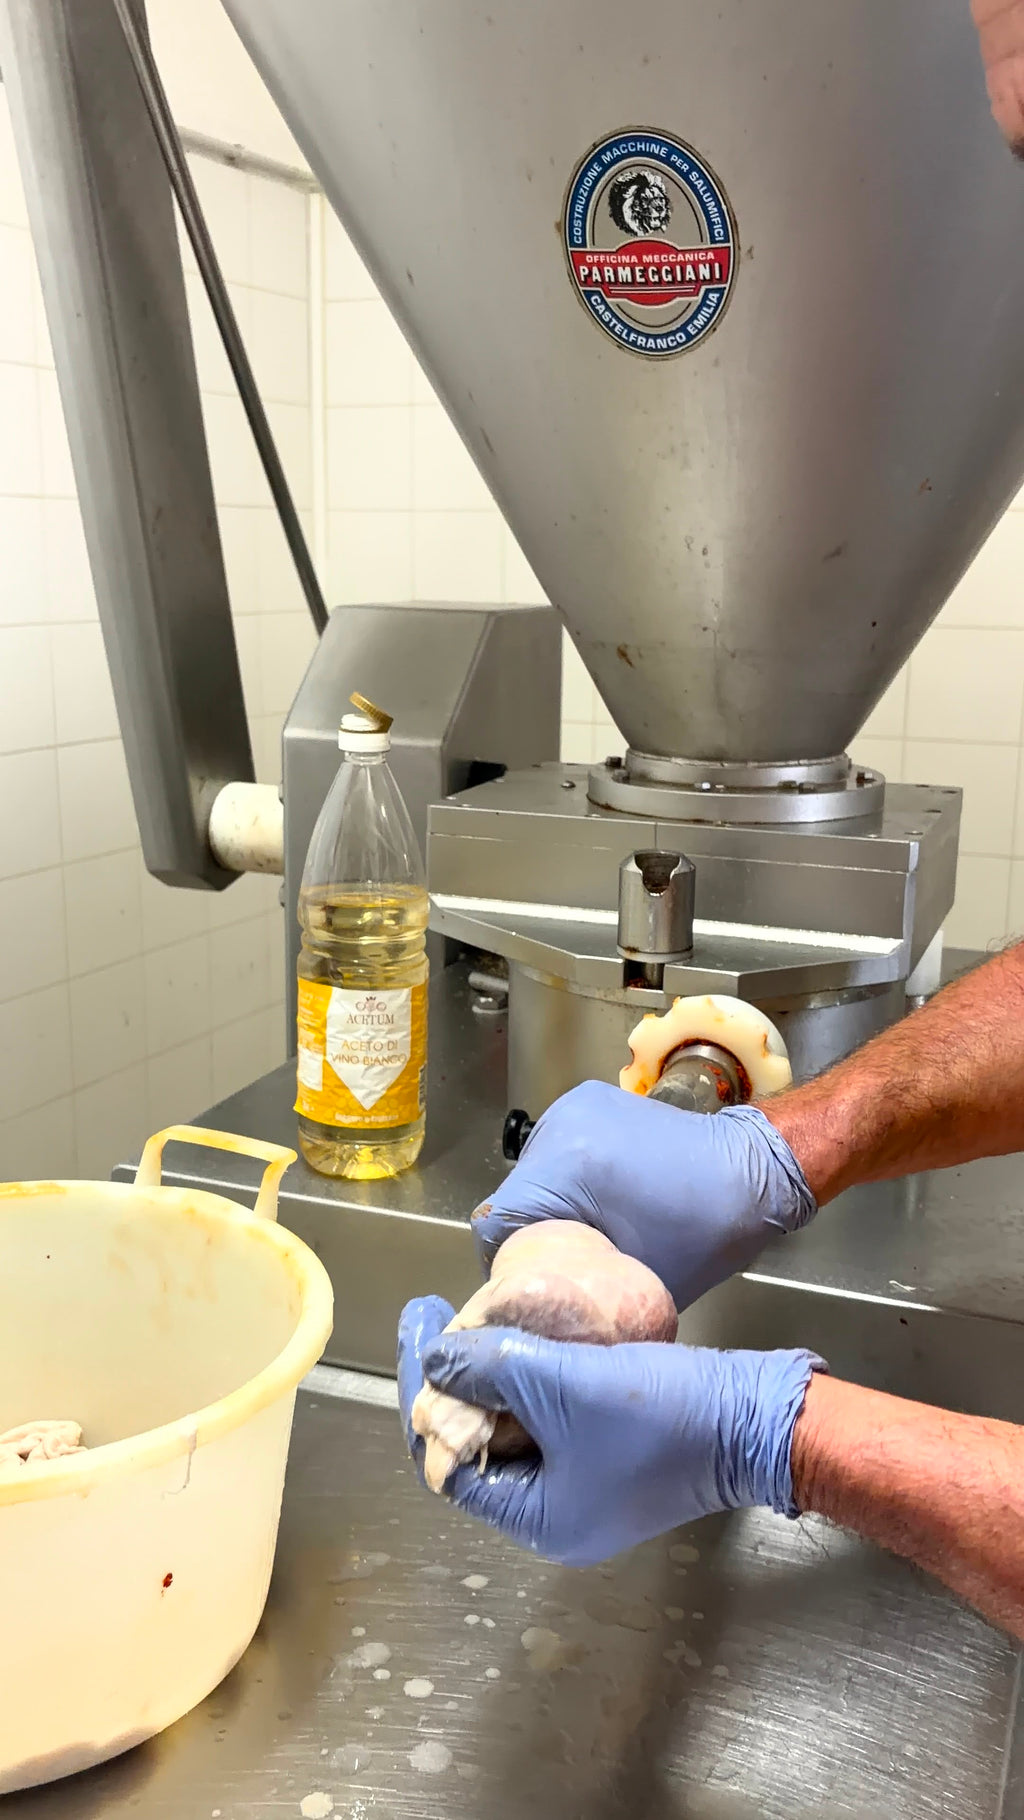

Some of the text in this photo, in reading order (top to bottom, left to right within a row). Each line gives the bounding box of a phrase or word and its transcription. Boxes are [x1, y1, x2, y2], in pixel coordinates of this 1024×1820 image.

[573, 141, 725, 244] COSTRUZIONE MACCHINE PER SALUMIFICI
[586, 251, 715, 264] OFFICINA MECCANICA
[580, 262, 722, 284] PARMEGGIANI
[590, 291, 720, 350] CASTELFRANCO EMILIA
[341, 1039, 398, 1052] ACETO DI
[330, 1053, 408, 1066] VINO BIANCO
